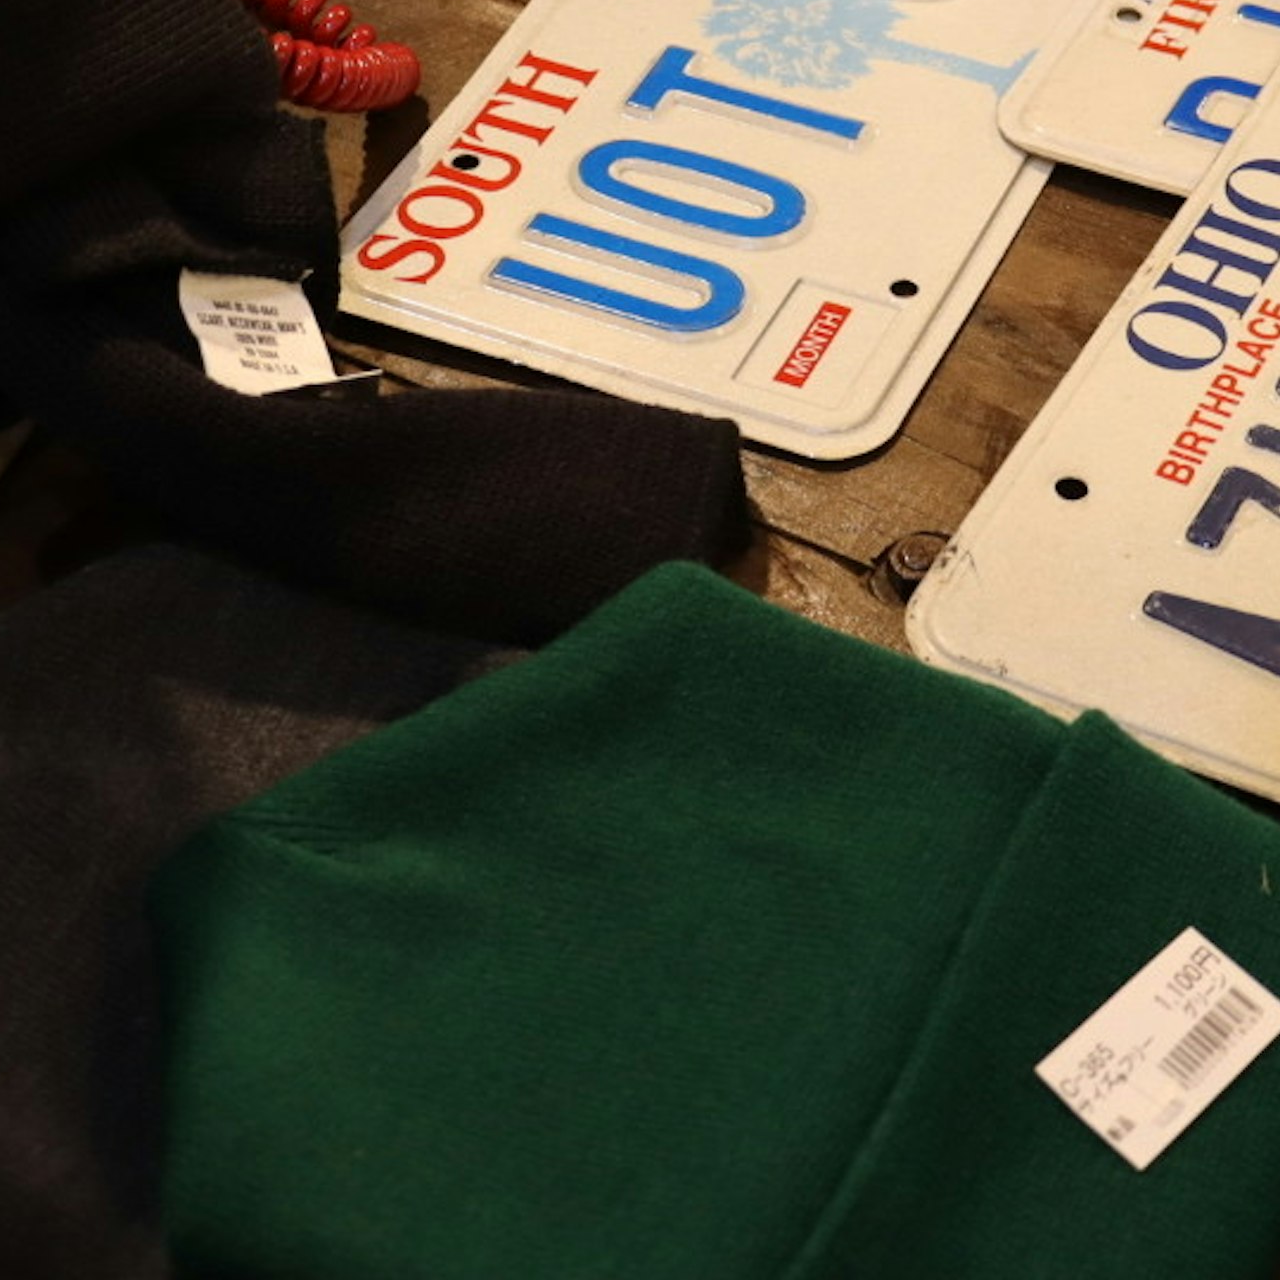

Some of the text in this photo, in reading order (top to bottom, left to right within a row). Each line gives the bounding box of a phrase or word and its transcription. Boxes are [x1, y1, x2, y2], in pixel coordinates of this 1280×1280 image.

[358, 50, 599, 286] SOUTH
[488, 45, 867, 334] UOT
[783, 310, 844, 379] MONTH
